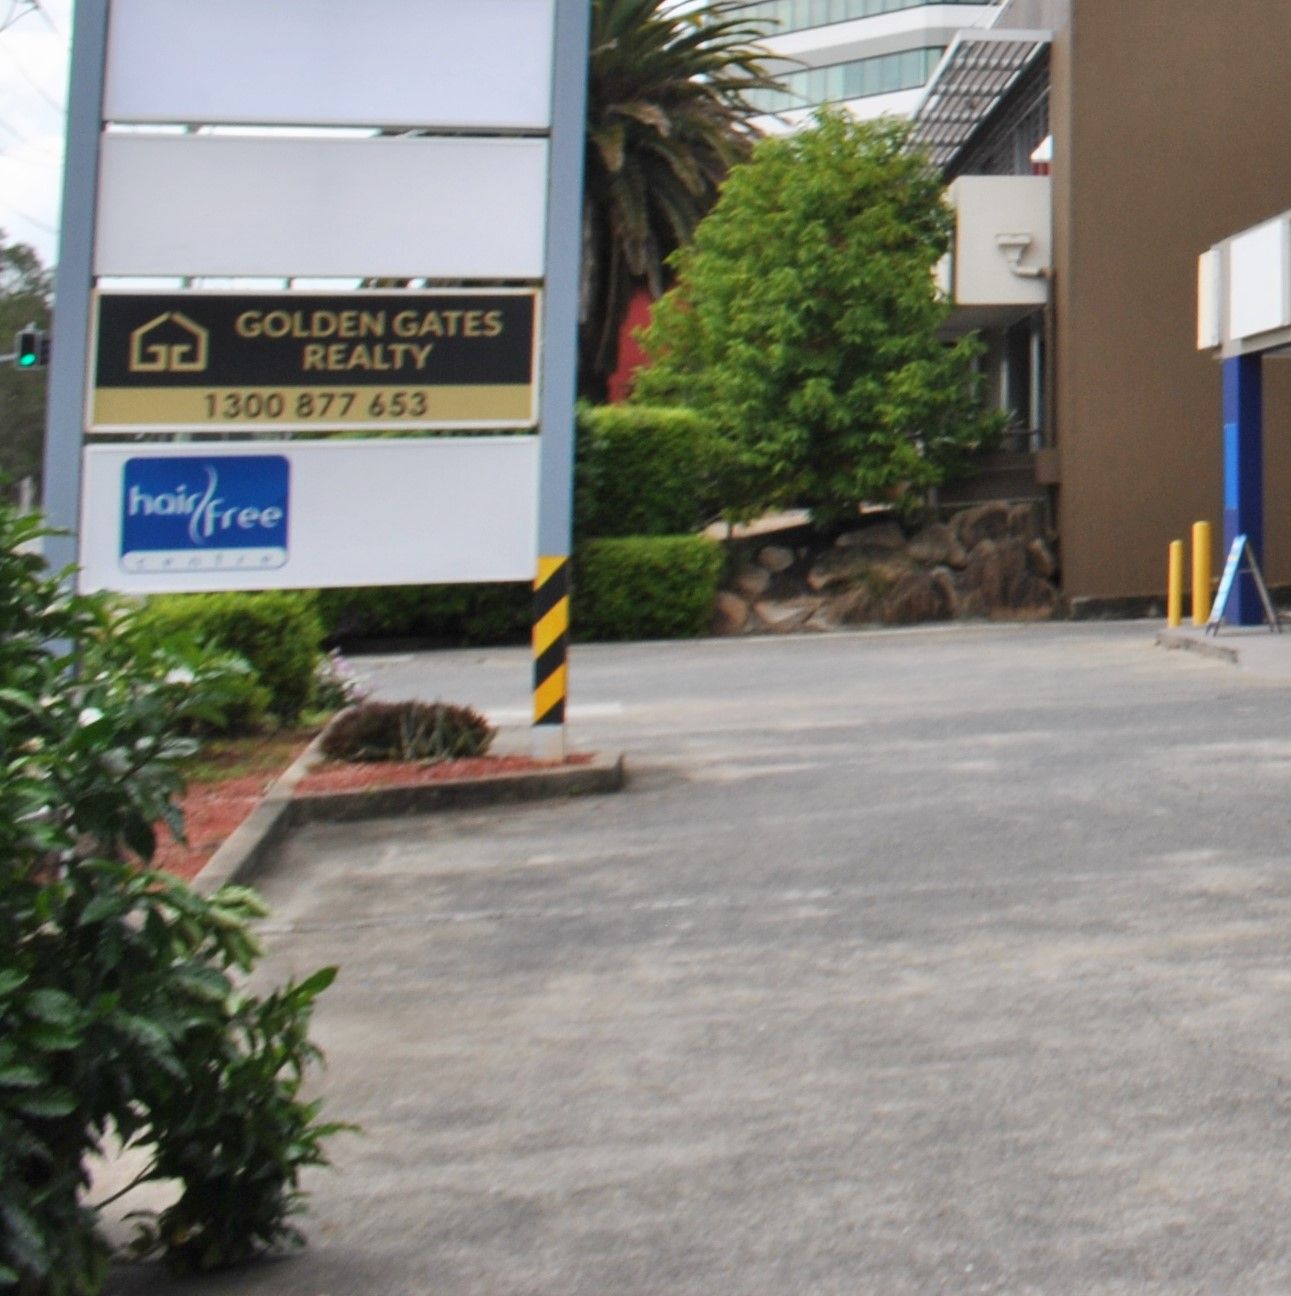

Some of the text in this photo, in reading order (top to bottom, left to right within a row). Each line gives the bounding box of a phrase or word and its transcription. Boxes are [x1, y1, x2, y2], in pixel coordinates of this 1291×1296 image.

[235, 309, 502, 339] GOLDEN GATES
[303, 343, 433, 371] REALTY
[204, 391, 428, 419] 1300 877 653
[129, 483, 283, 538] hair free
